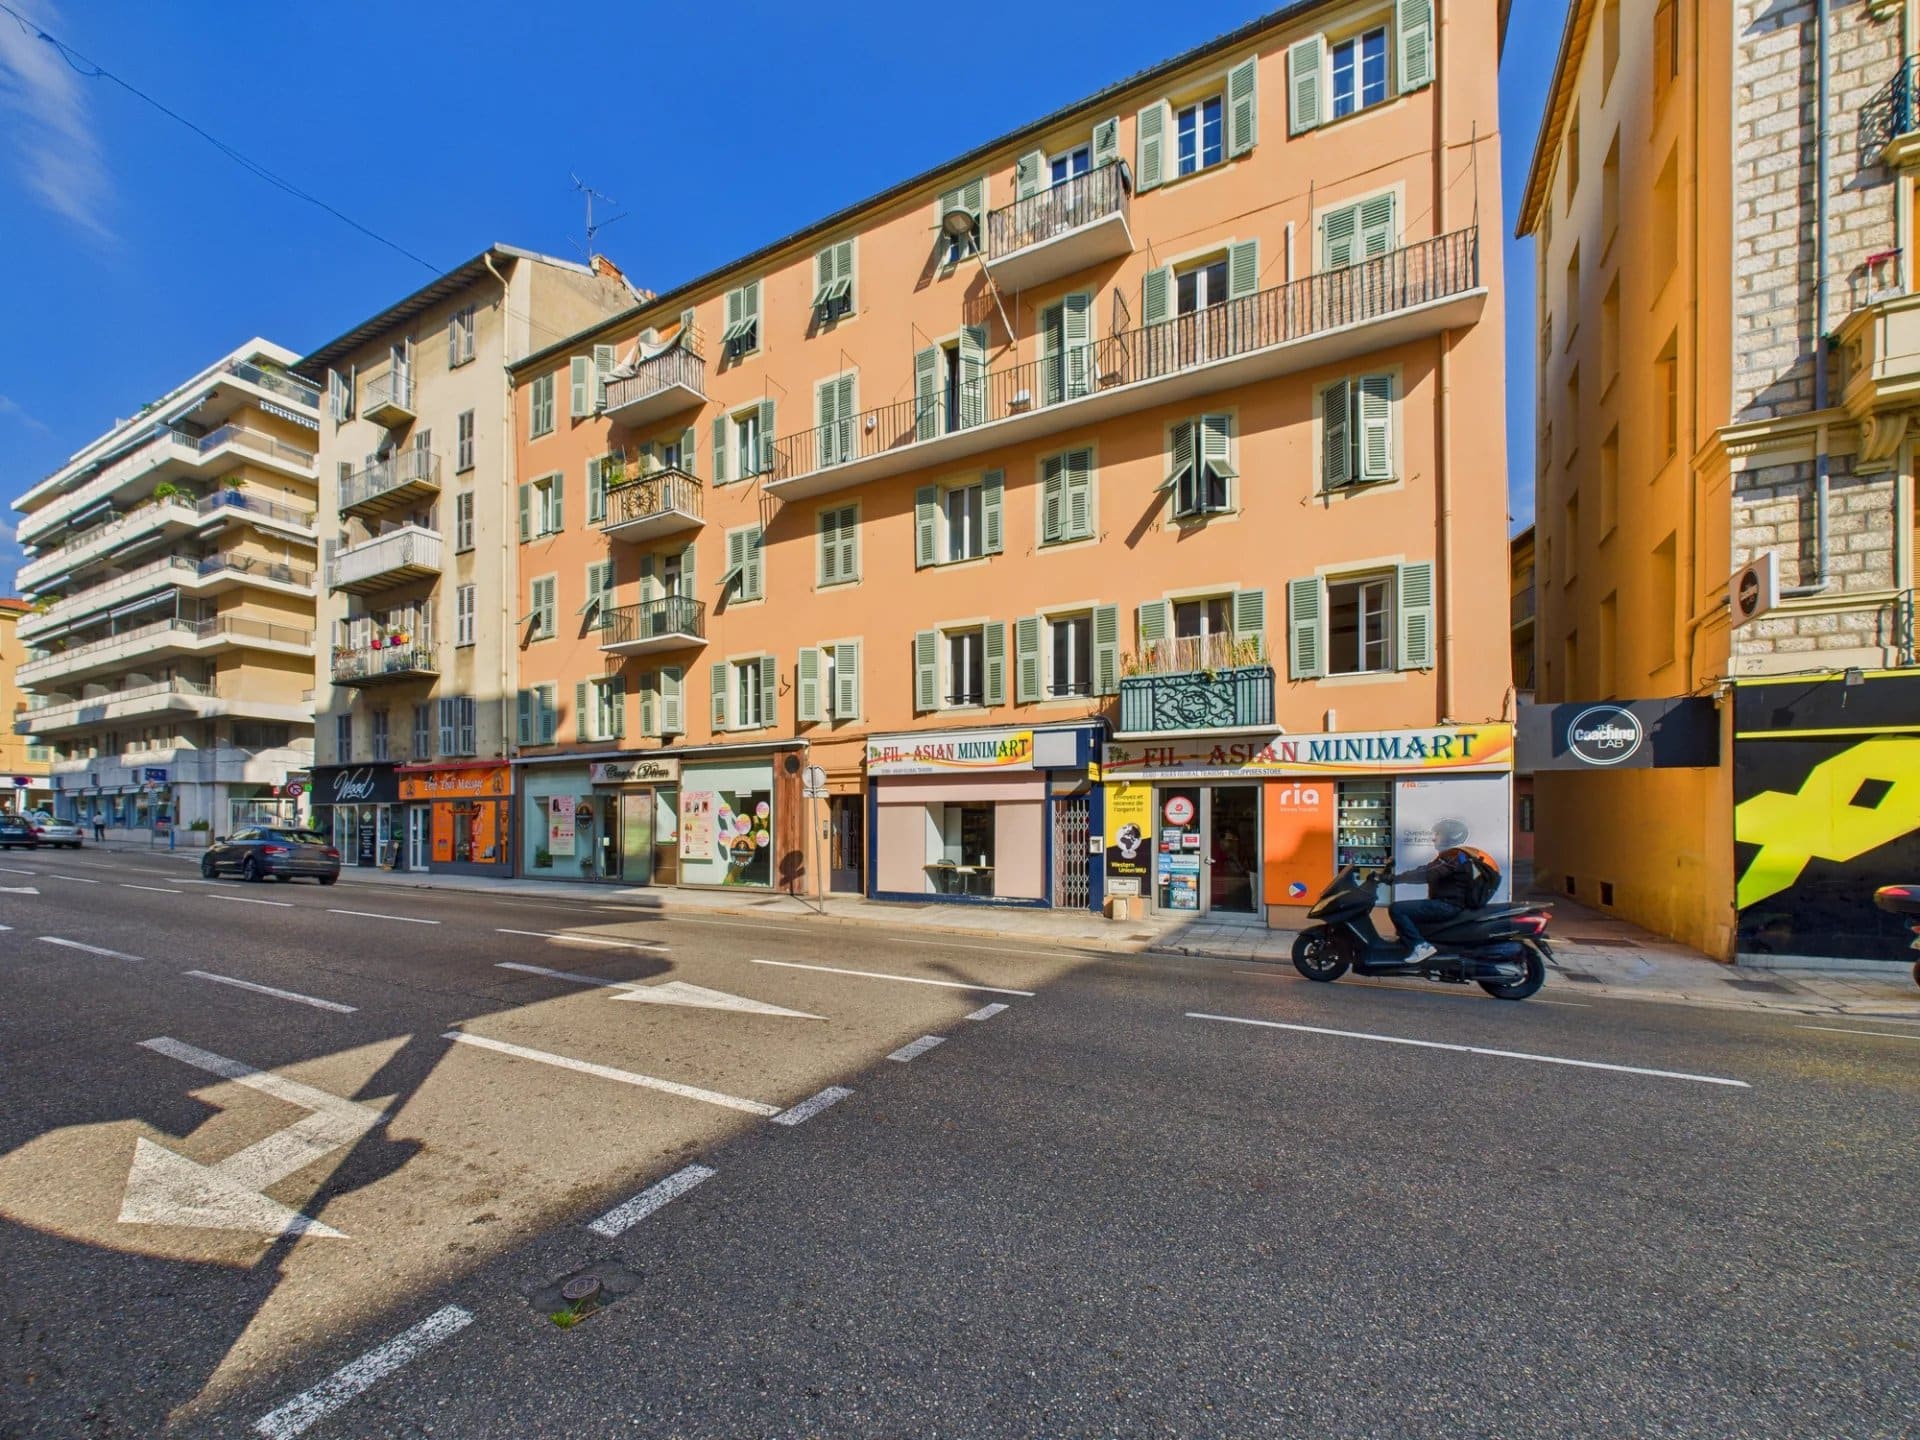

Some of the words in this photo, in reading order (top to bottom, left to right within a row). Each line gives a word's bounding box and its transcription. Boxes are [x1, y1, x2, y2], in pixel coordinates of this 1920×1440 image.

[1574, 728, 1636, 741] Coaching
[1598, 740, 1625, 749] LAB
[883, 746, 903, 762] FIL
[913, 743, 955, 761] ASIAN
[957, 739, 1029, 760] MINIMART
[1143, 747, 1184, 768] FIL
[1206, 742, 1300, 767] ASIAN
[1308, 733, 1479, 763] MINIMART
[333, 767, 375, 802] Wood
[1280, 782, 1320, 806] ria
